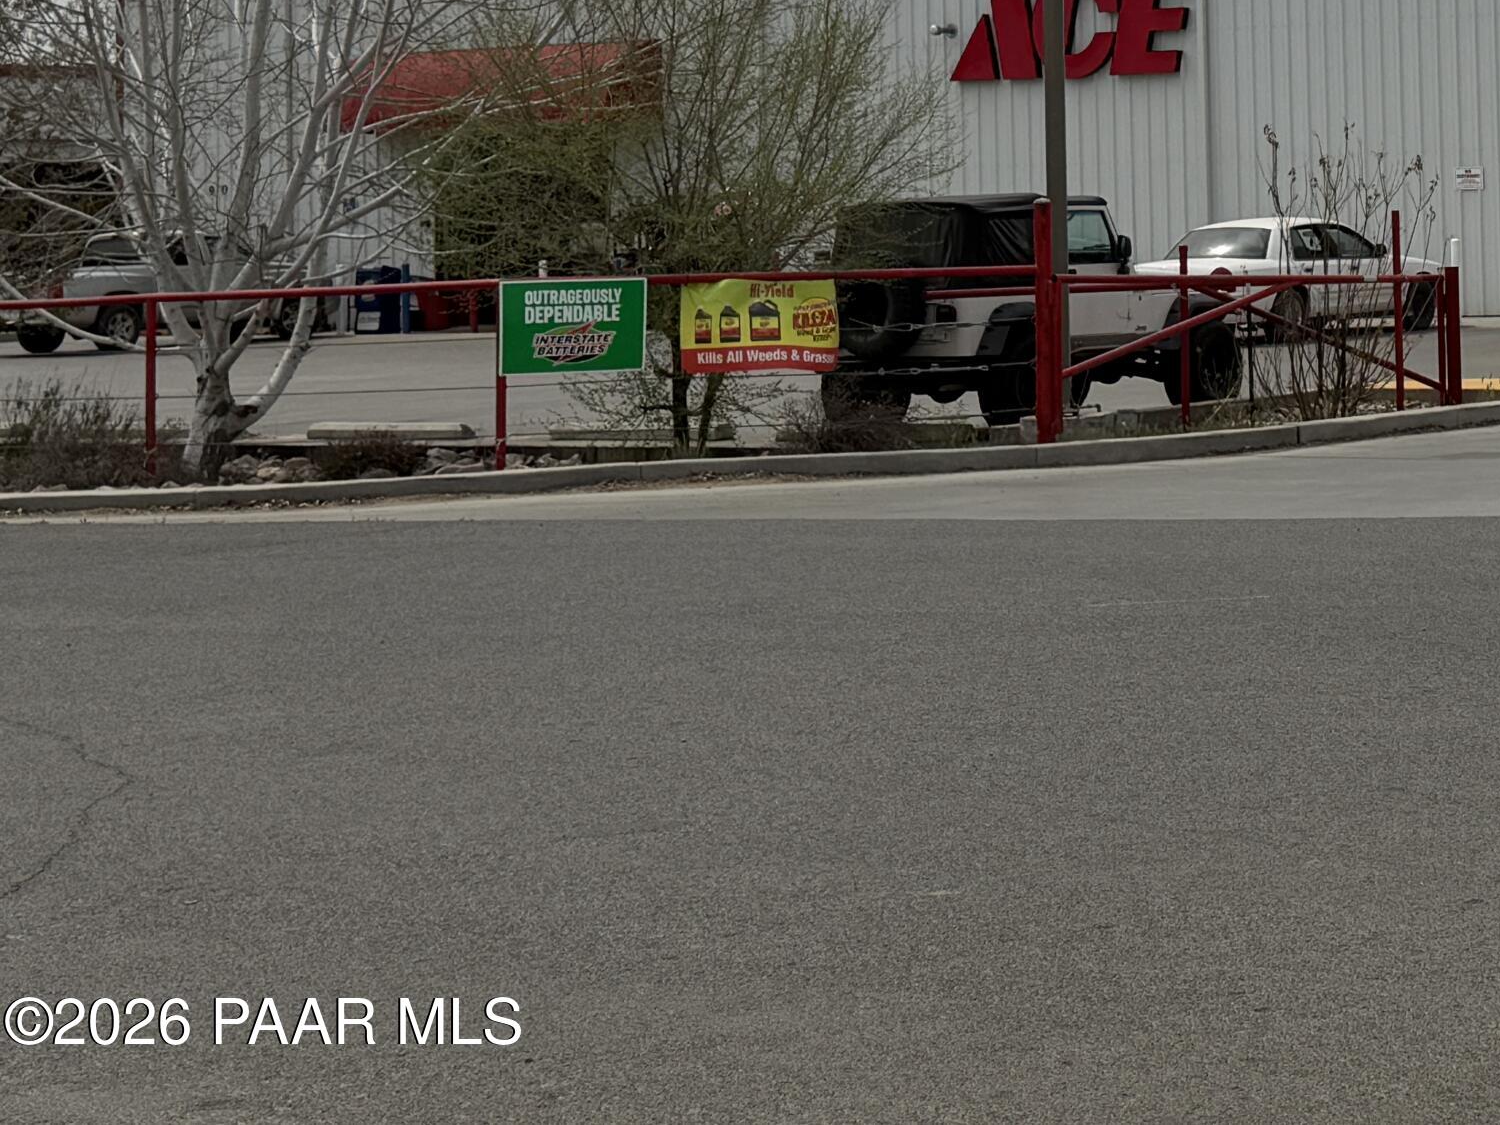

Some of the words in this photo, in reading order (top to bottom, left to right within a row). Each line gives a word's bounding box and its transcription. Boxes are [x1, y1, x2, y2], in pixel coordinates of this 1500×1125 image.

[525, 288, 622, 305] OUTRAGEOUSLY
[750, 282, 795, 298] Hi-Yield
[525, 304, 620, 324] DEPENDABLE
[535, 333, 611, 345] INTERSTATE
[537, 345, 605, 356] BATTERIES
[696, 352, 723, 364] Kills
[726, 350, 743, 363] All
[746, 349, 788, 362] Weeds
[790, 349, 800, 362] &
